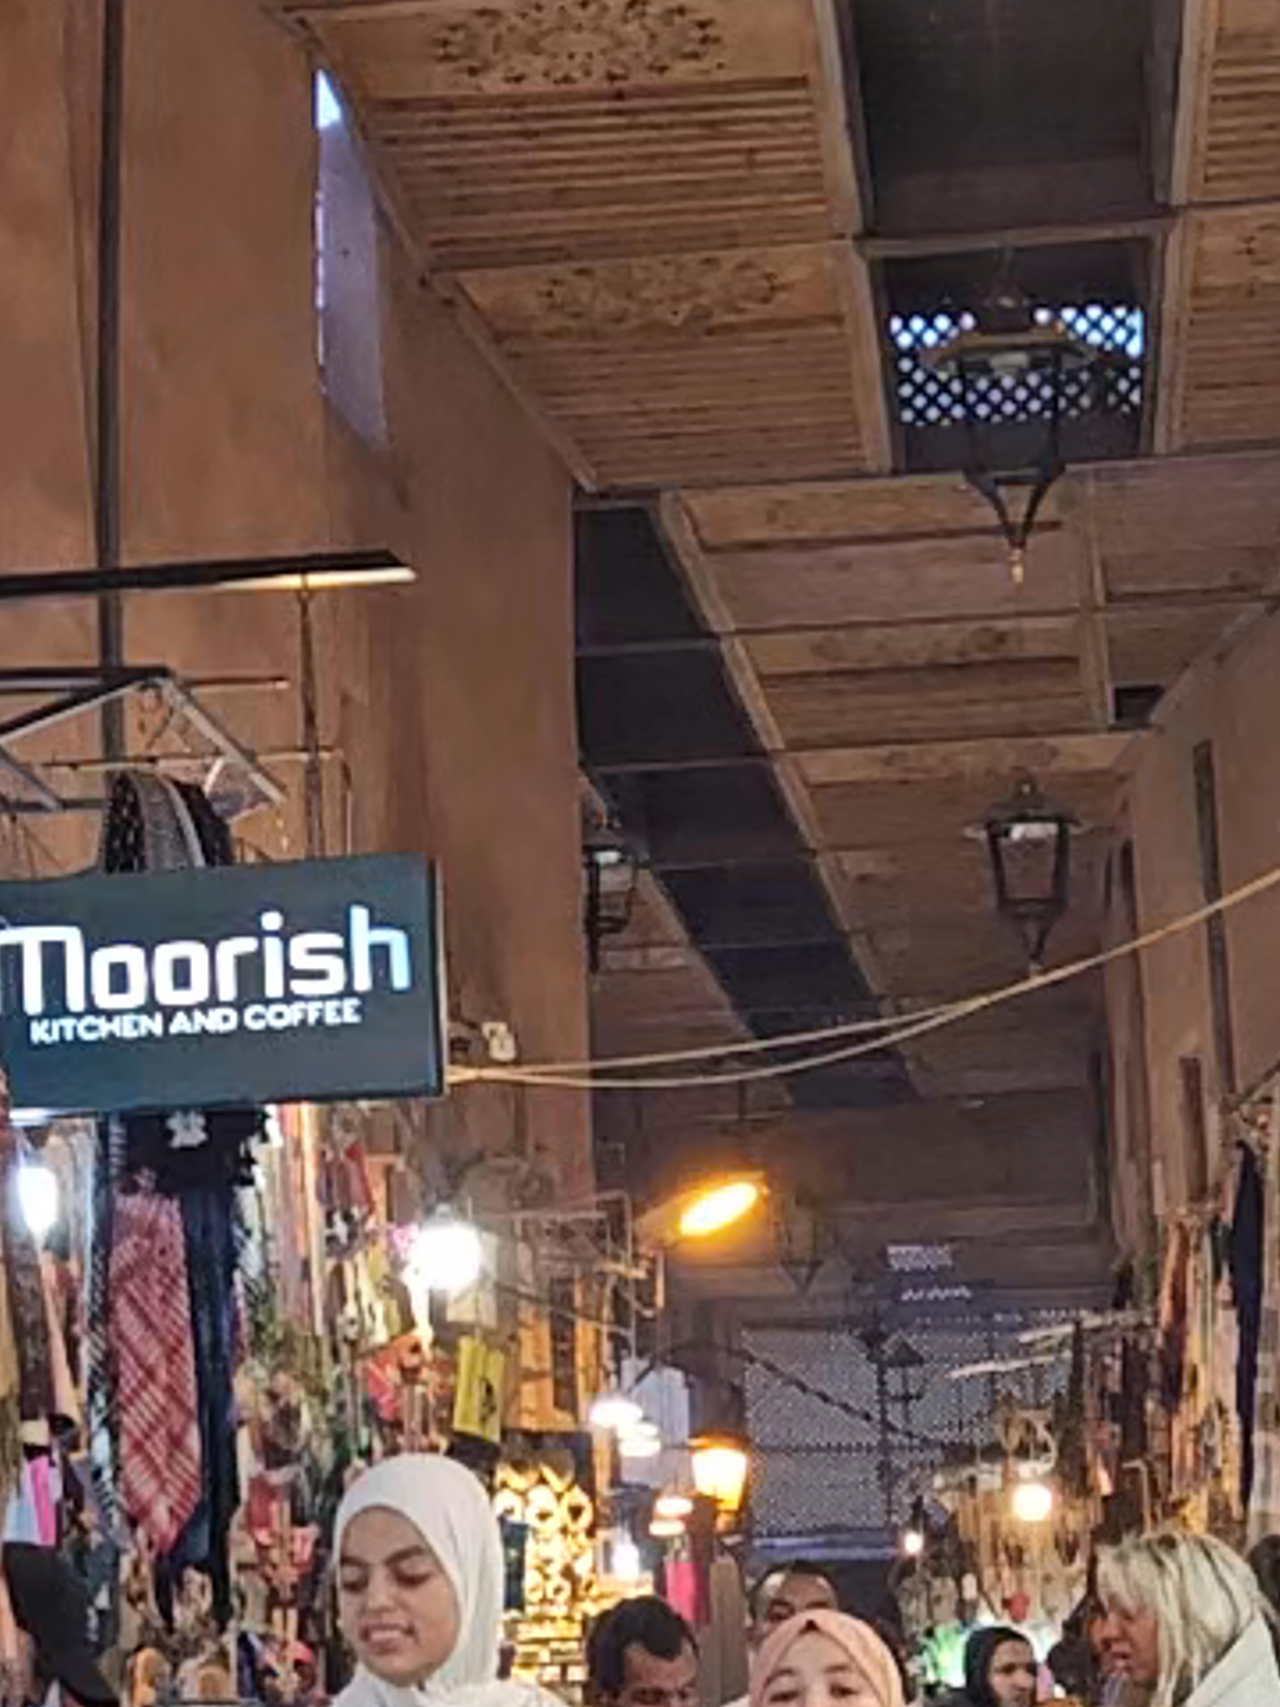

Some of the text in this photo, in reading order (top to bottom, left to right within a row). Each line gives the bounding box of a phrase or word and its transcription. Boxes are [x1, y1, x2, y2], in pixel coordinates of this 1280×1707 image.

[30, 997, 361, 1045] KITCHEN AND COFFEE
